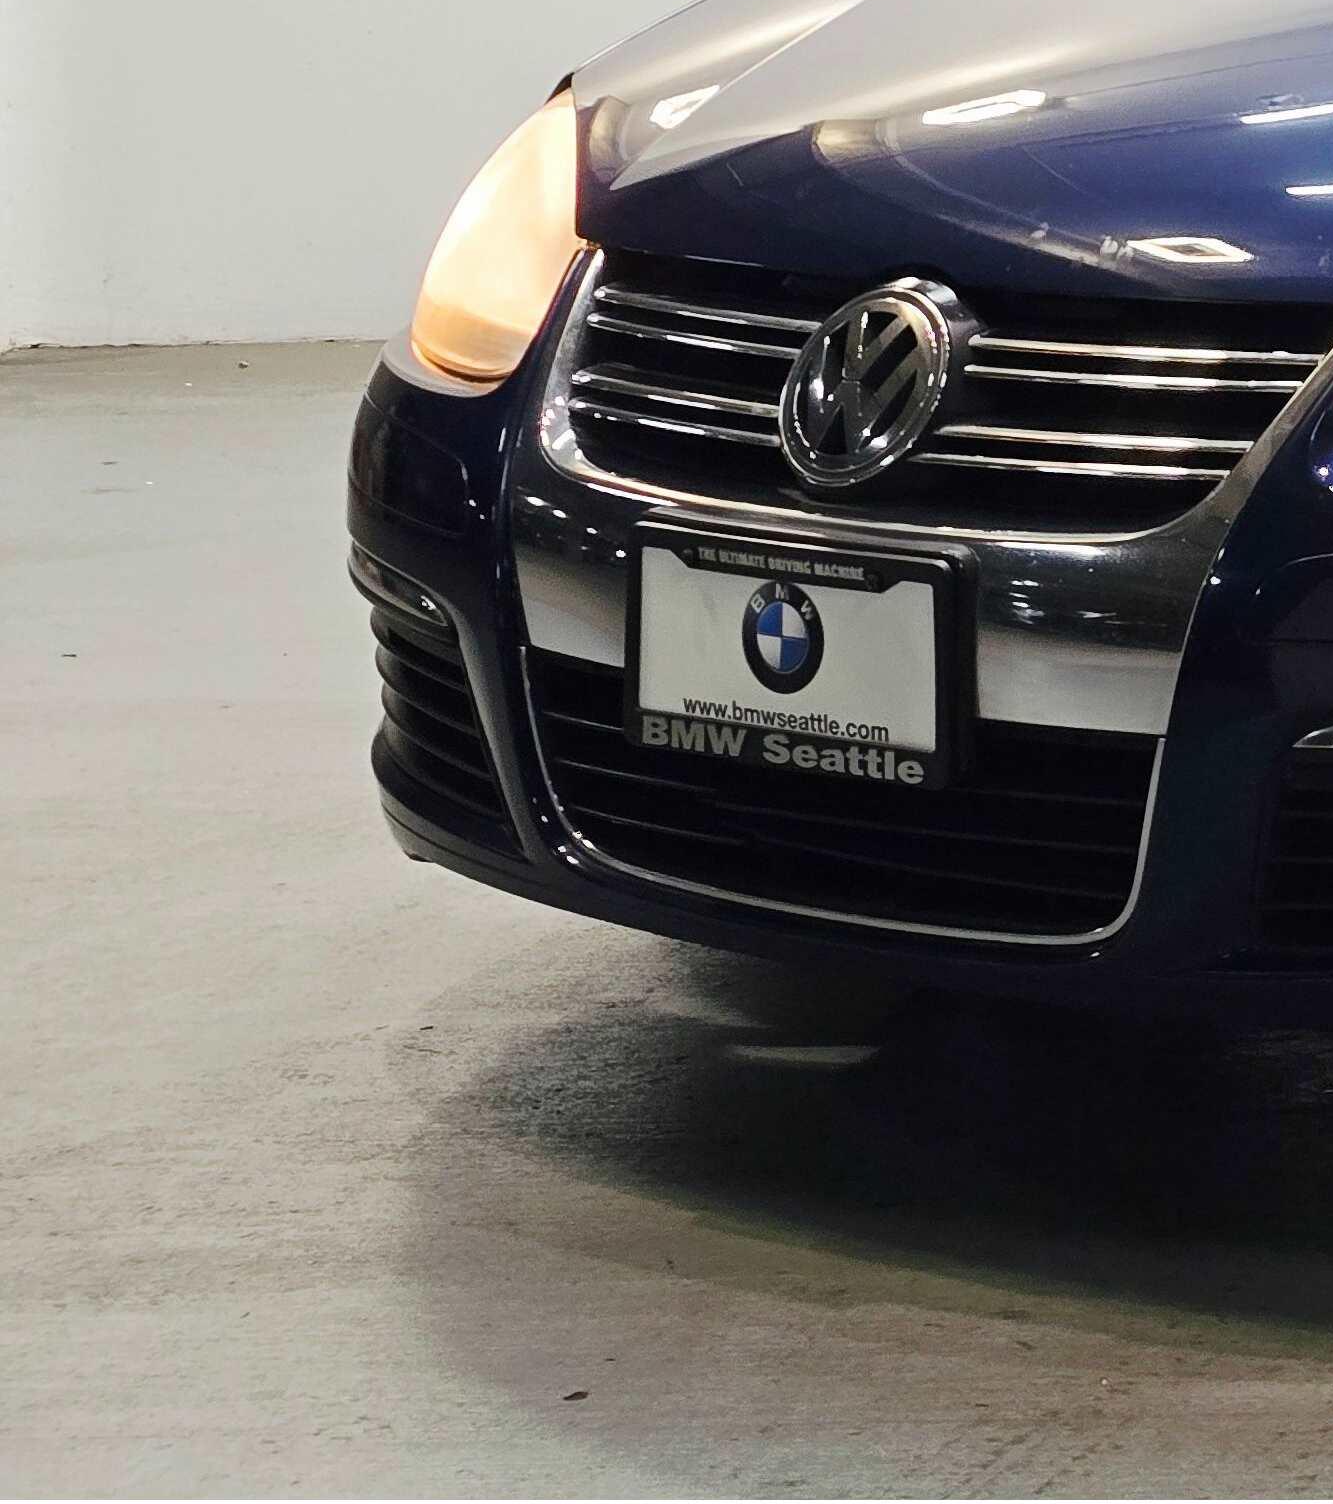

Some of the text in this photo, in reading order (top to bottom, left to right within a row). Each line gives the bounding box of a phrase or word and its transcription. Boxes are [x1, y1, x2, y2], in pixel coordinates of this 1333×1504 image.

[719, 549, 766, 569] ULTIMATE
[768, 558, 812, 575] DRIVING
[814, 563, 865, 581] MACHINE
[750, 583, 815, 621] BMW
[682, 698, 890, 742] www.bmwseattle.com
[641, 716, 925, 785] BMW Seattle
